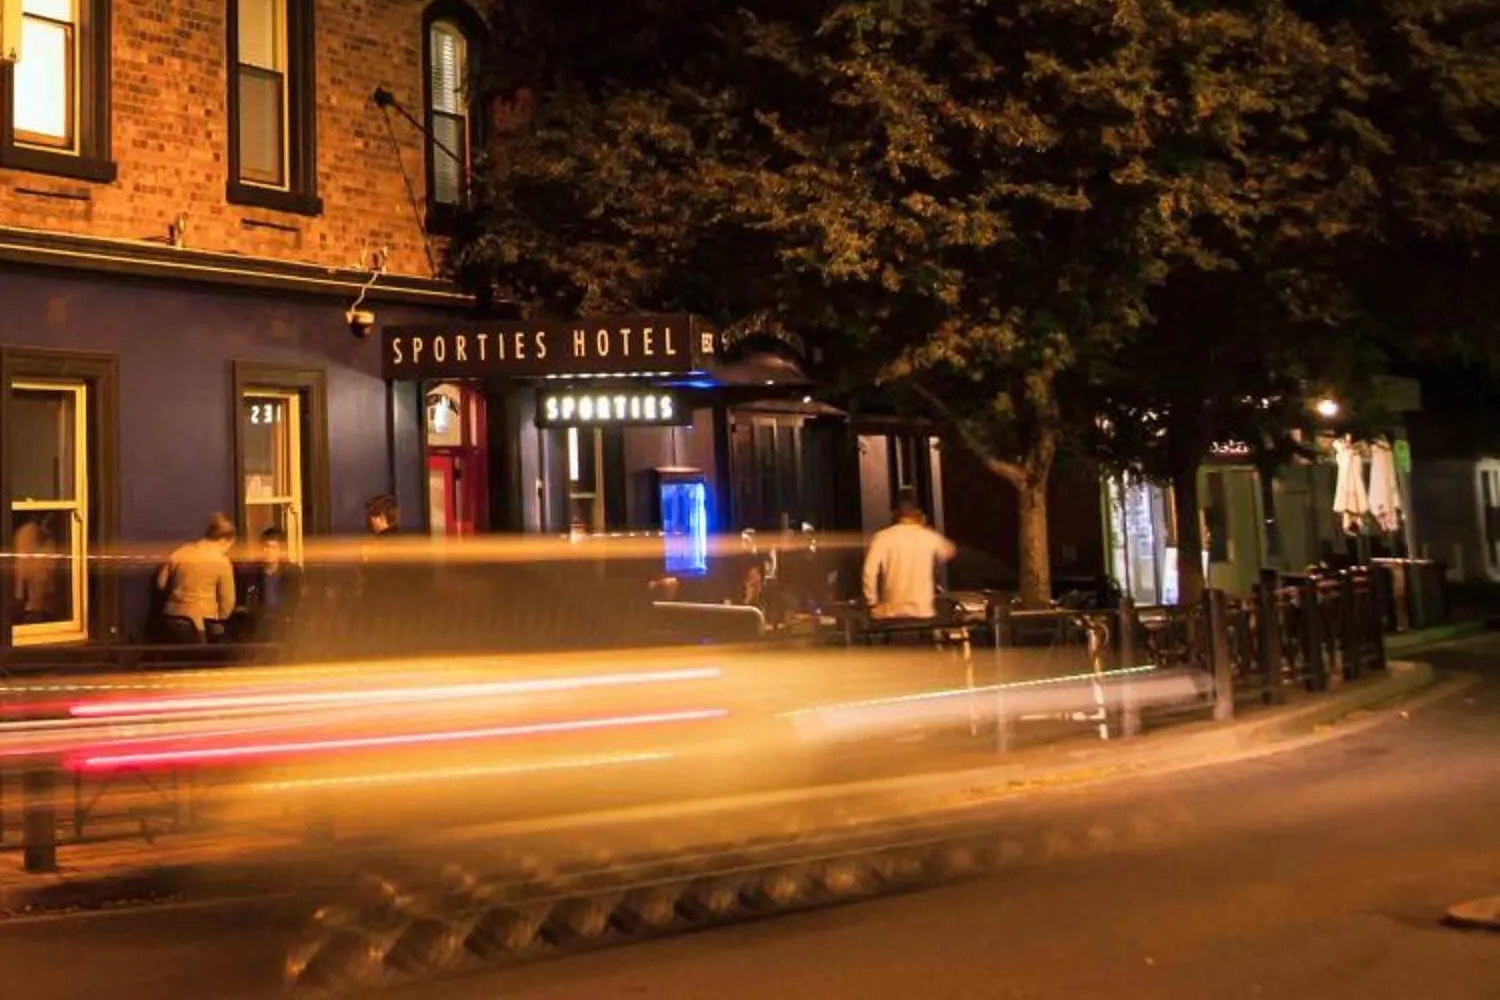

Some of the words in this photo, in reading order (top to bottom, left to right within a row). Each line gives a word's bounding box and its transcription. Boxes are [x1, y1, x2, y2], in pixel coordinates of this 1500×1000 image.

[393, 331, 547, 364] SPORTIES
[573, 327, 677, 357] HOTEL
[546, 395, 673, 421] SPORTIES
